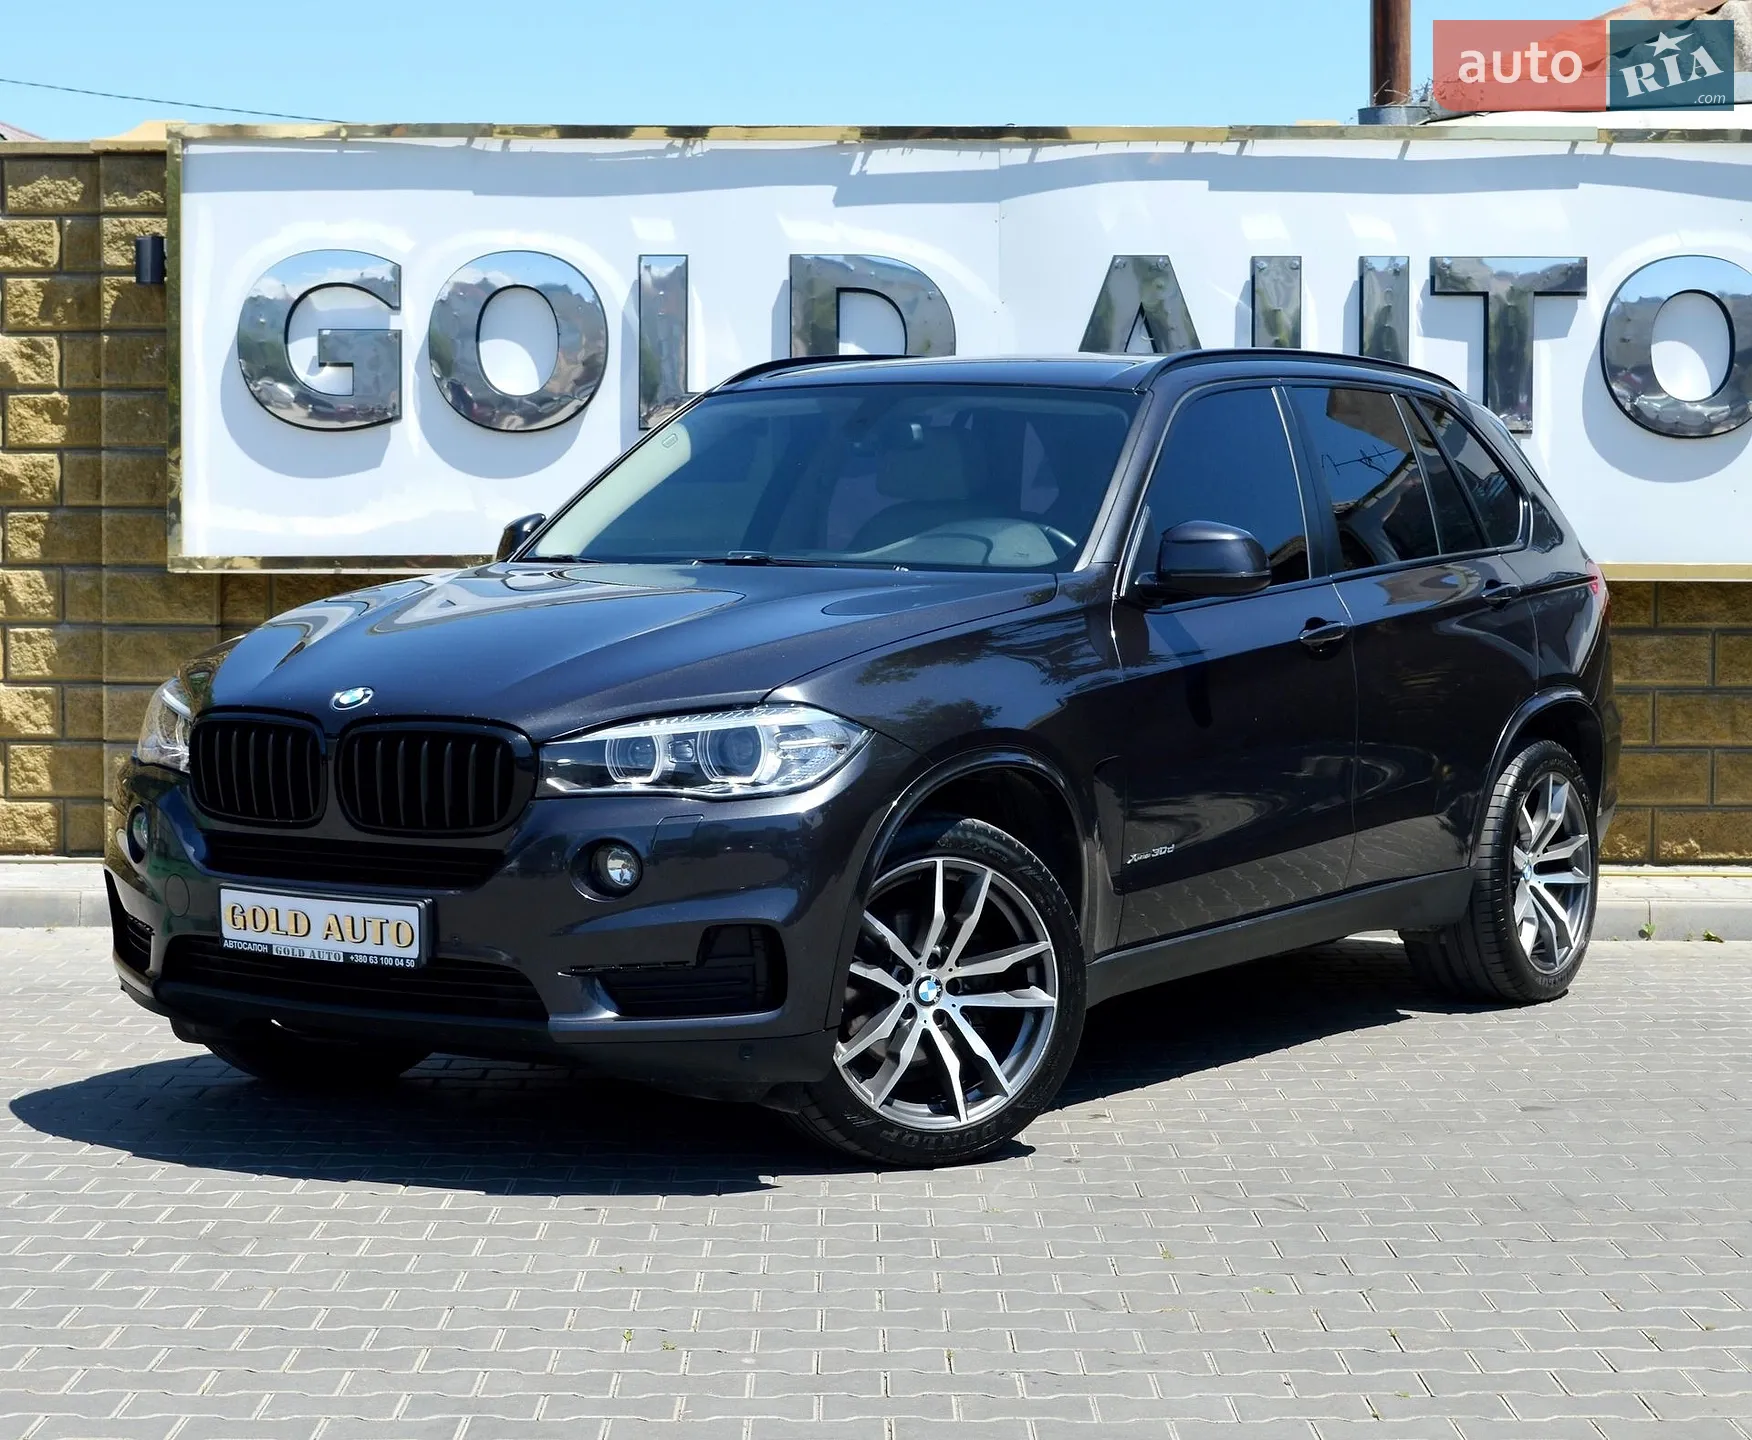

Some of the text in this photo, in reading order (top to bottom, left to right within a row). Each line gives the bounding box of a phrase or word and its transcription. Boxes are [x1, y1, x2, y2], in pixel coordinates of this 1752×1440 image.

[237, 249, 957, 433] GOLD
[225, 903, 415, 948] GOLD AUTO
[223, 940, 269, 954] АВТОСАЛОН
[275, 945, 342, 962] GOLD AUTO
[349, 954, 416, 969] +380 63 100 04 50
